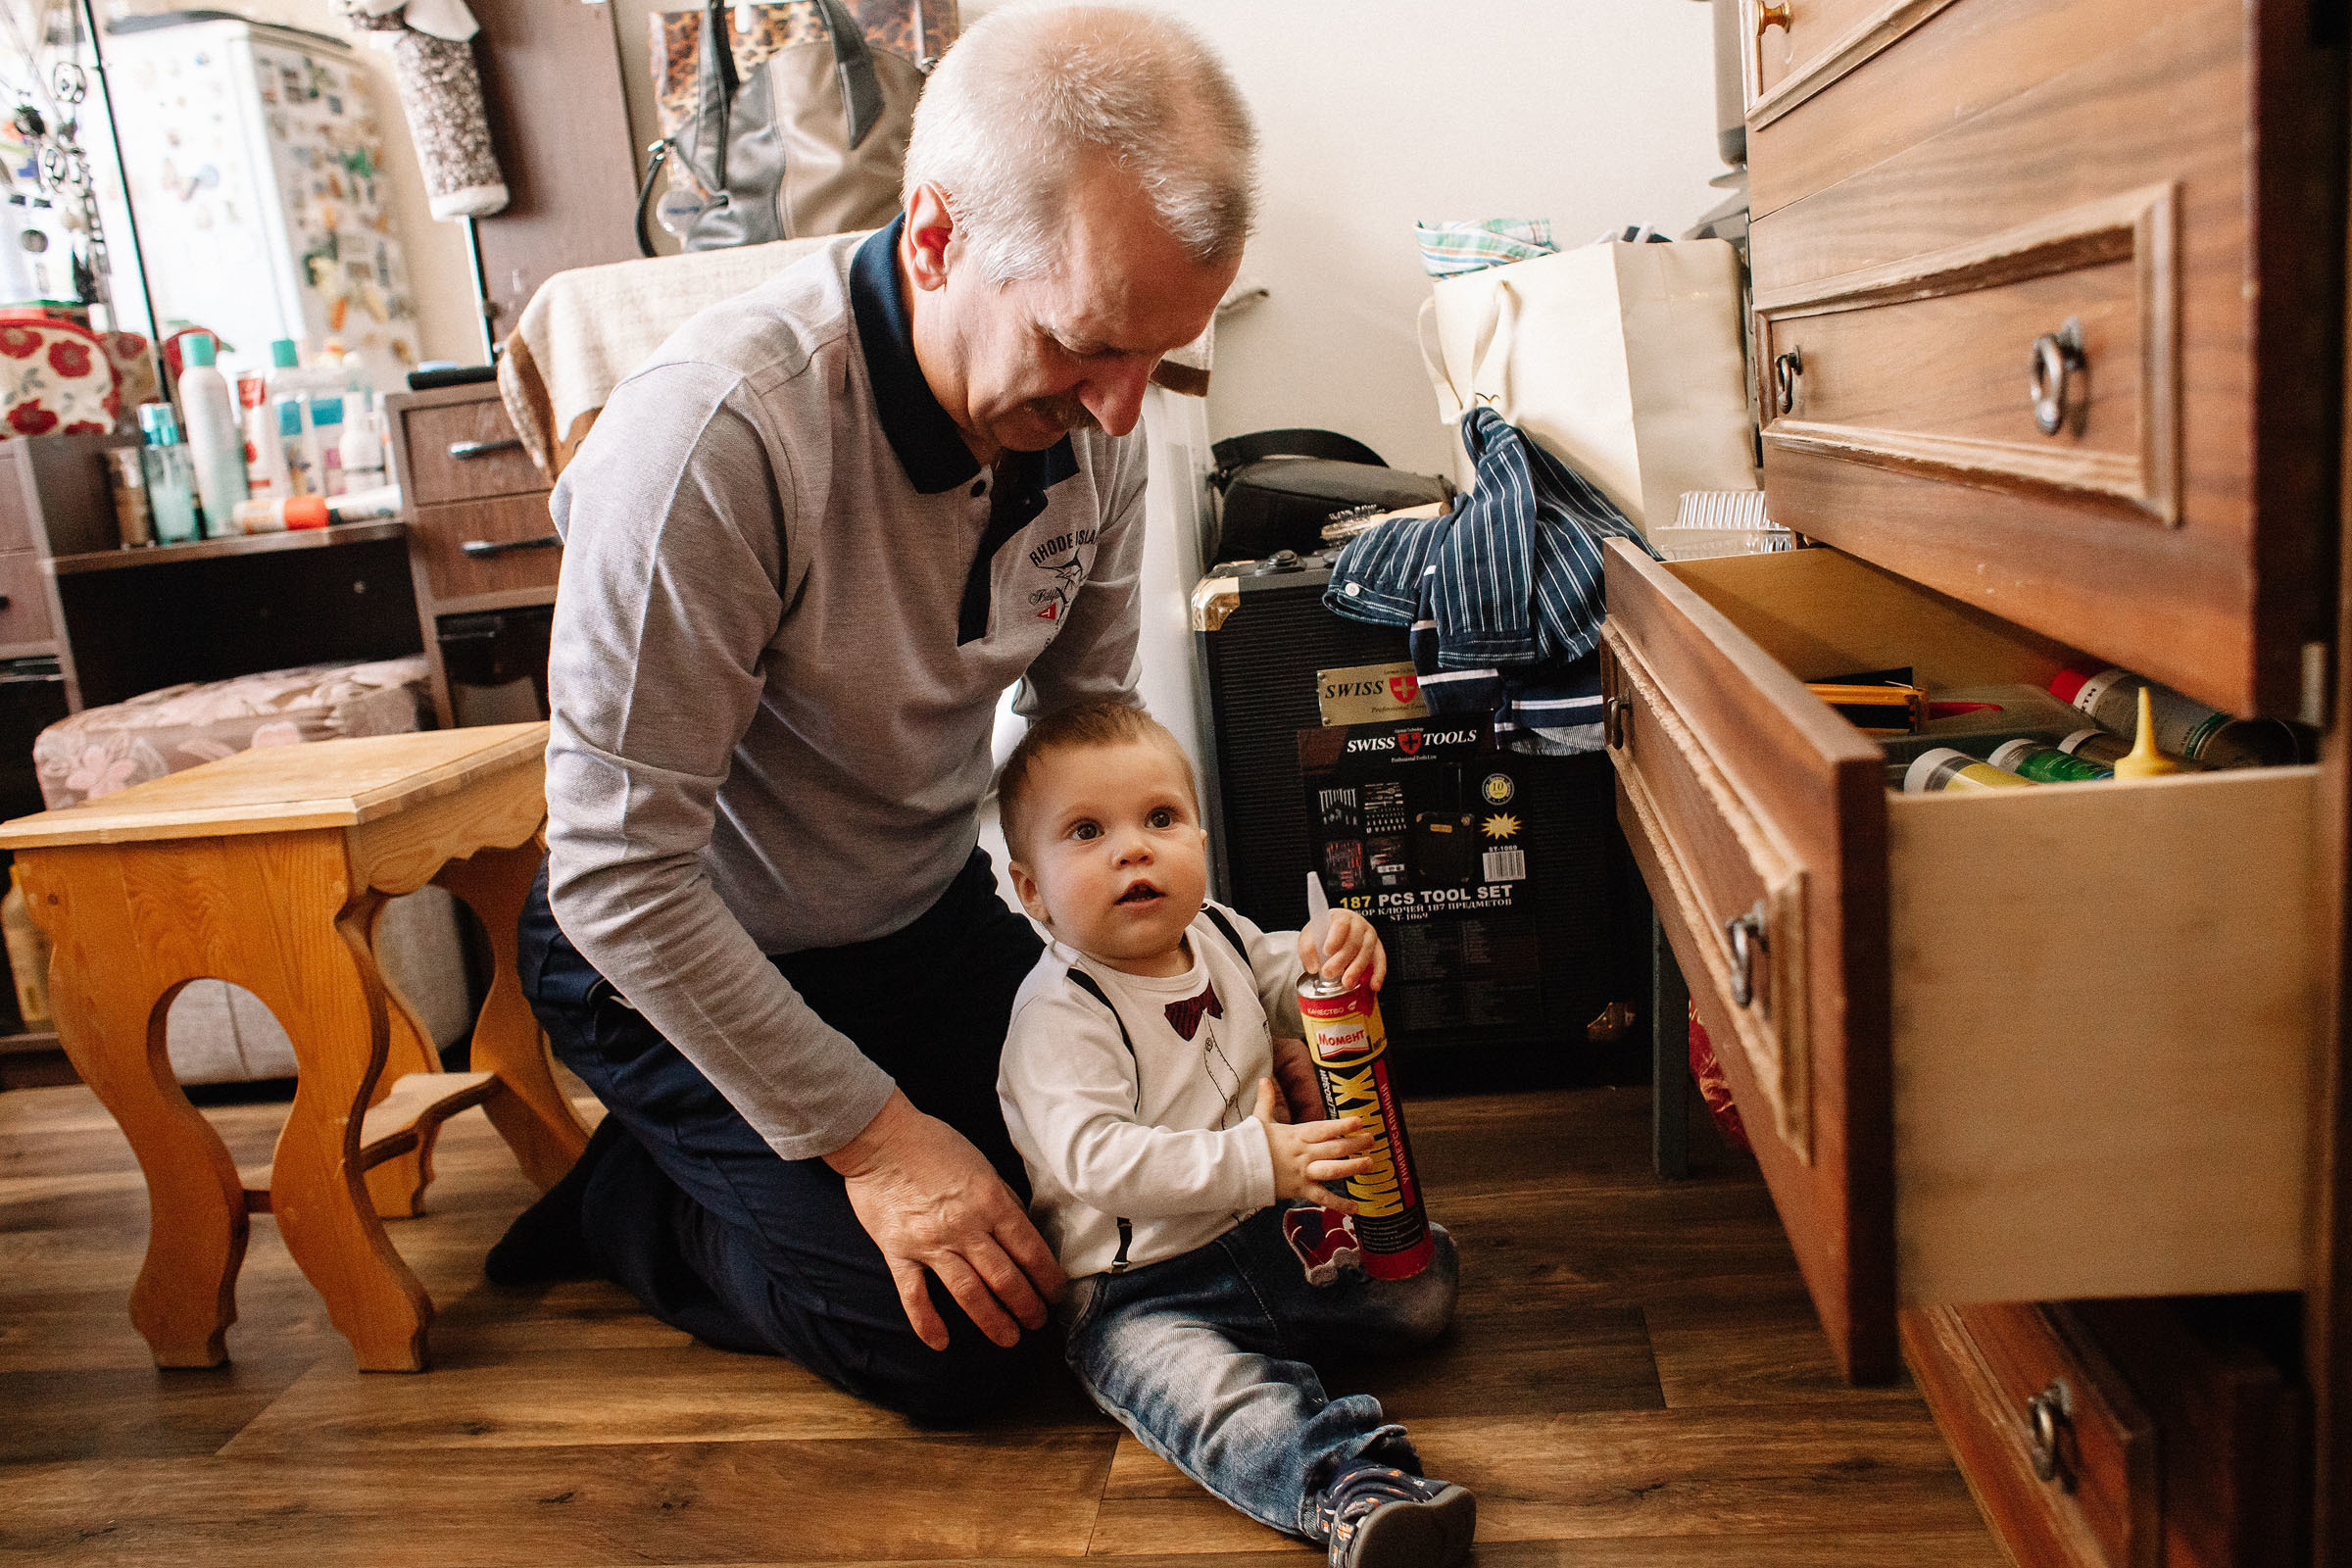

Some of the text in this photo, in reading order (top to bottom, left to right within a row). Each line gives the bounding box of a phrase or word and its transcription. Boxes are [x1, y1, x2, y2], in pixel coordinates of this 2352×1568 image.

[1029, 529, 1096, 566] RHODE ISLA
[1325, 680, 1384, 699] SWISS
[1347, 729, 1477, 753] SWISS TOOLS
[1493, 782, 1504, 792] 10
[1340, 884, 1513, 908] 187 PCS TOOL SET
[1378, 904, 1424, 915] КЛЮЧЕЙ
[1428, 903, 1446, 911] 187
[1447, 897, 1512, 910] ПРЕДМЕТОВ
[1307, 1006, 1345, 1016] КАЧЕСТВО
[1318, 1029, 1365, 1047] Момент
[1381, 1082, 1411, 1185] УНИВЕРСАЛЬНЫЙ
